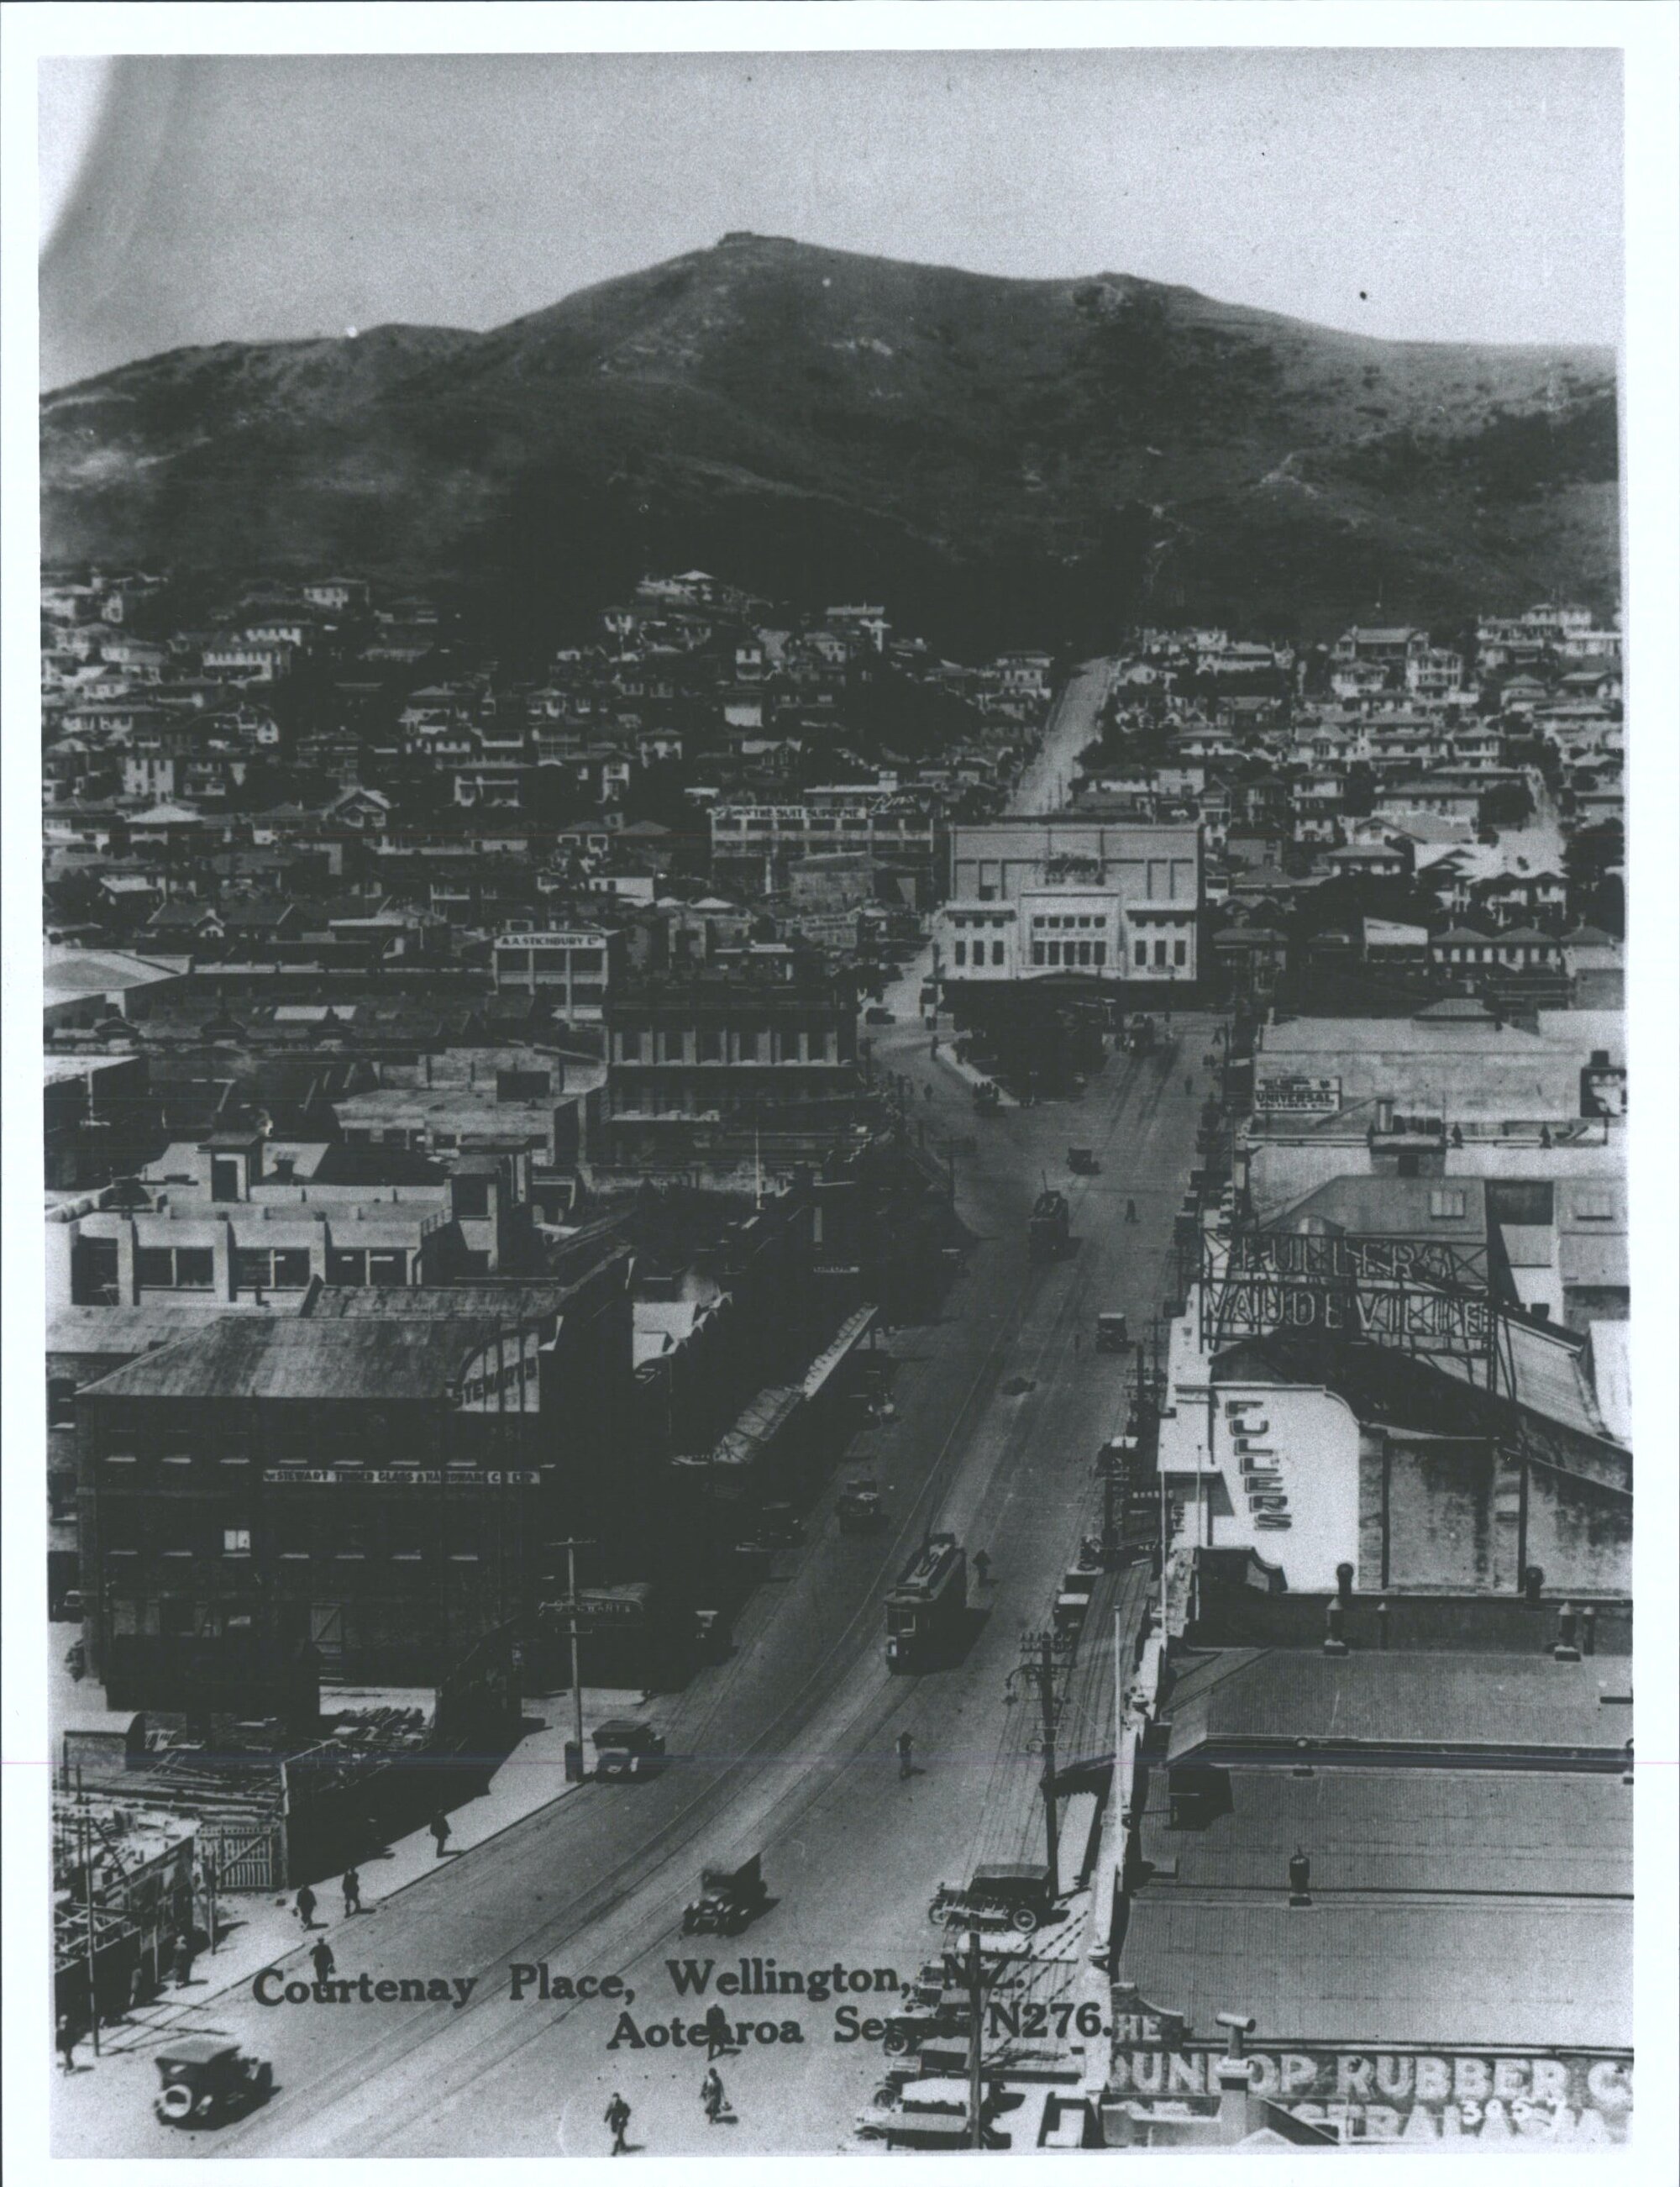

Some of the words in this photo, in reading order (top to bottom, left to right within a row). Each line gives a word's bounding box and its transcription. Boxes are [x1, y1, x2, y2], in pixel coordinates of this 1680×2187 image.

[776, 808, 803, 818] SUIT
[807, 809, 858, 818] SUPREME
[1256, 1094, 1334, 1103] UNIVERSAL
[1226, 1401, 1292, 1531] FULLERS
[276, 1471, 328, 1481] STEWART
[378, 1471, 414, 1482] GLASS
[426, 1472, 486, 1483] HADWARE
[1115, 2015, 1163, 2042] HE
[1336, 2055, 1569, 2104] RUBBER
